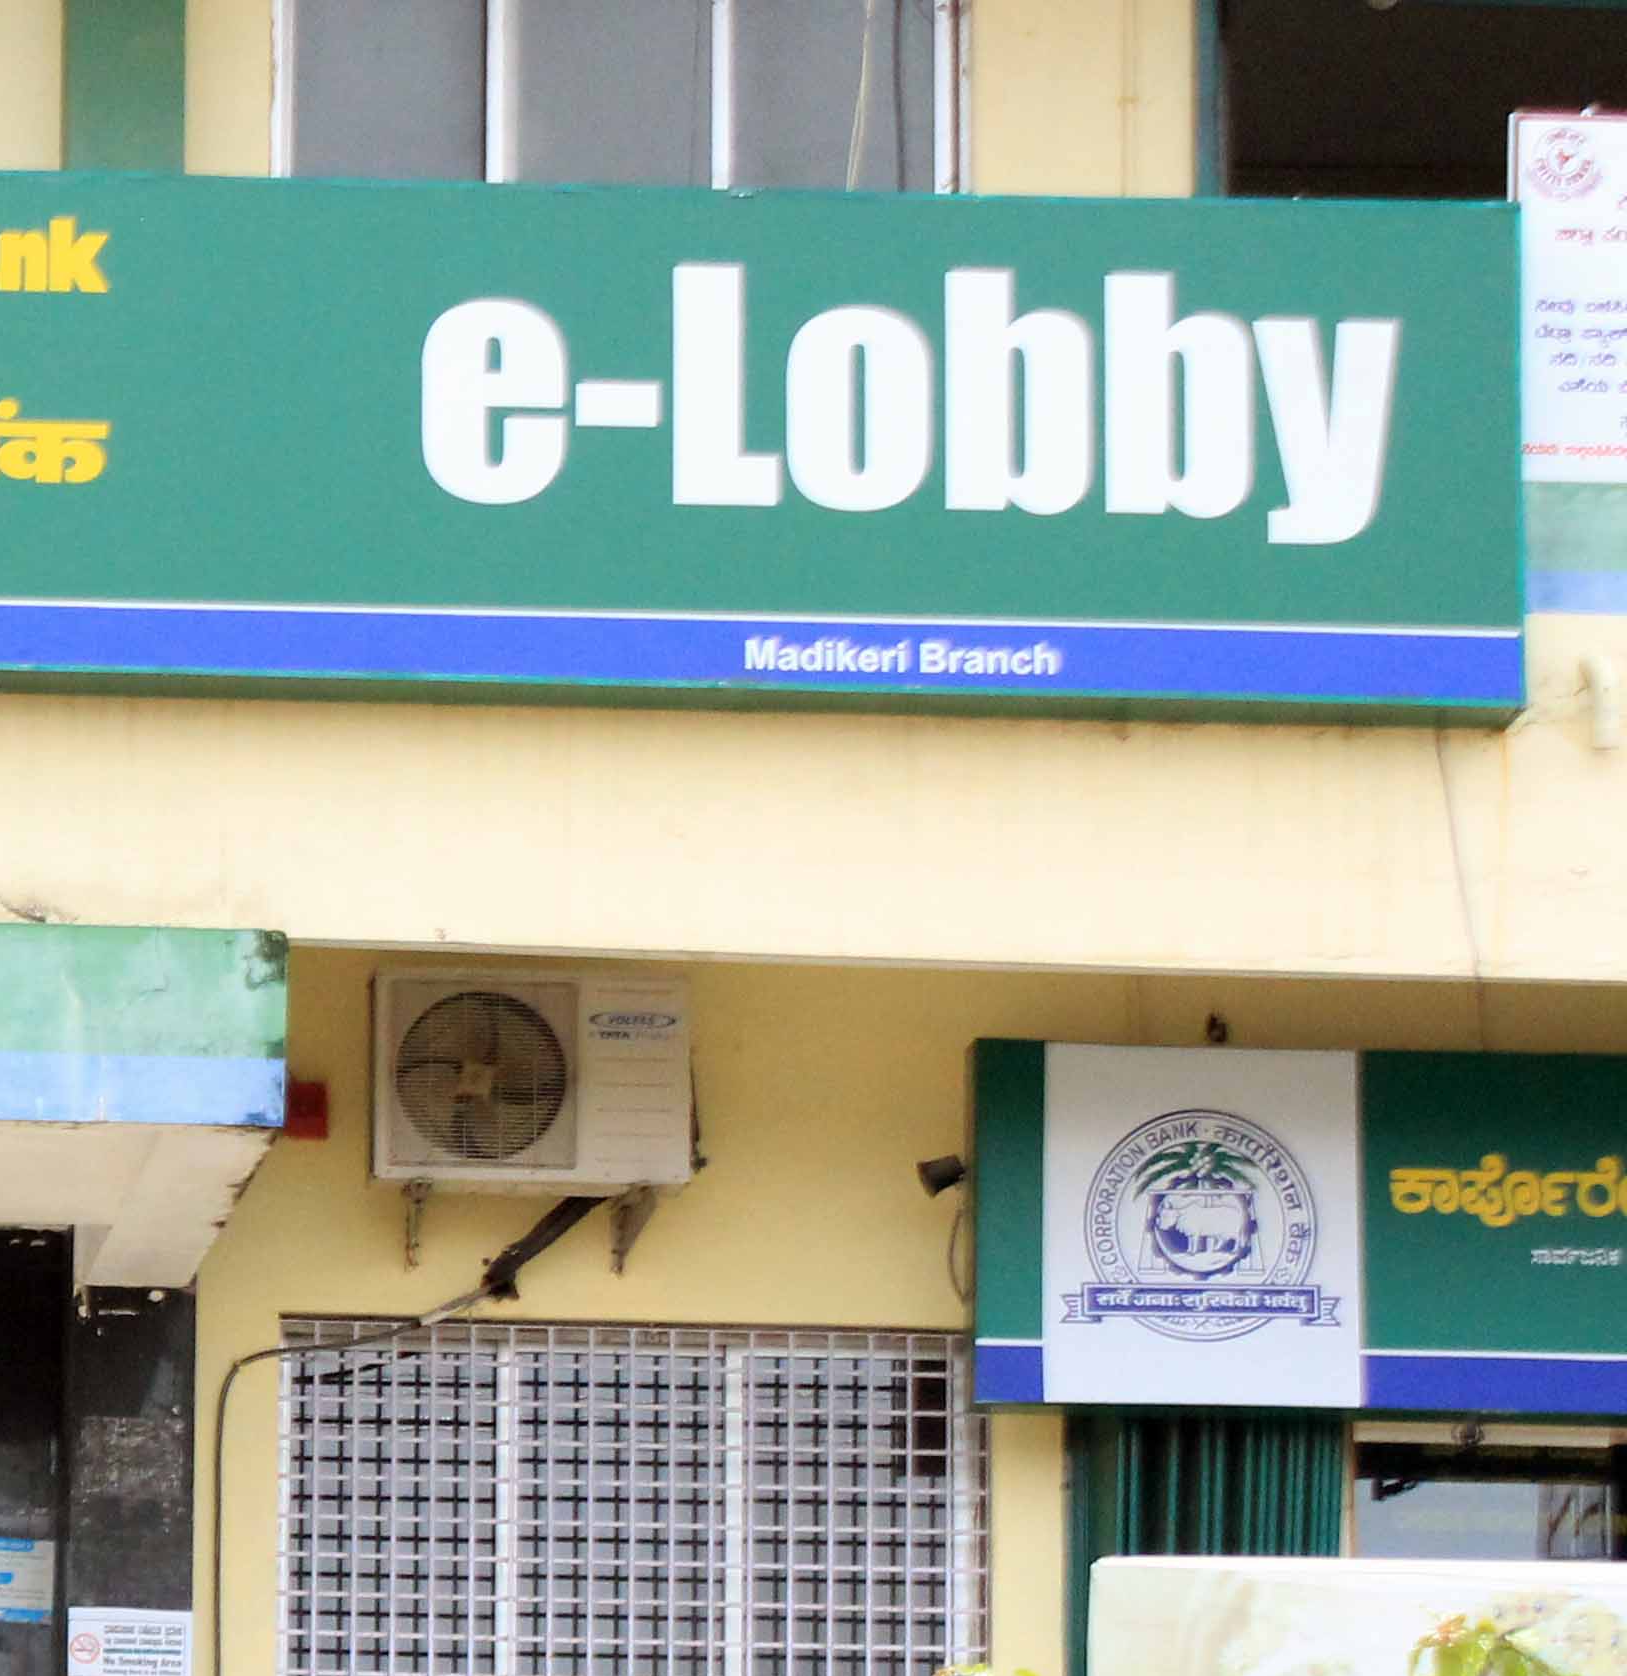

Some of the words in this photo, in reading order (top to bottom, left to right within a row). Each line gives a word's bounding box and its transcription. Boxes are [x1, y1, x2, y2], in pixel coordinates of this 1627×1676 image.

[420, 262, 1402, 546] e-Lobby
[744, 636, 911, 674] Madikeri
[918, 639, 1063, 676] Branch
[1094, 1143, 1147, 1266] CORPORATION
[1146, 1121, 1198, 1150] BANK
